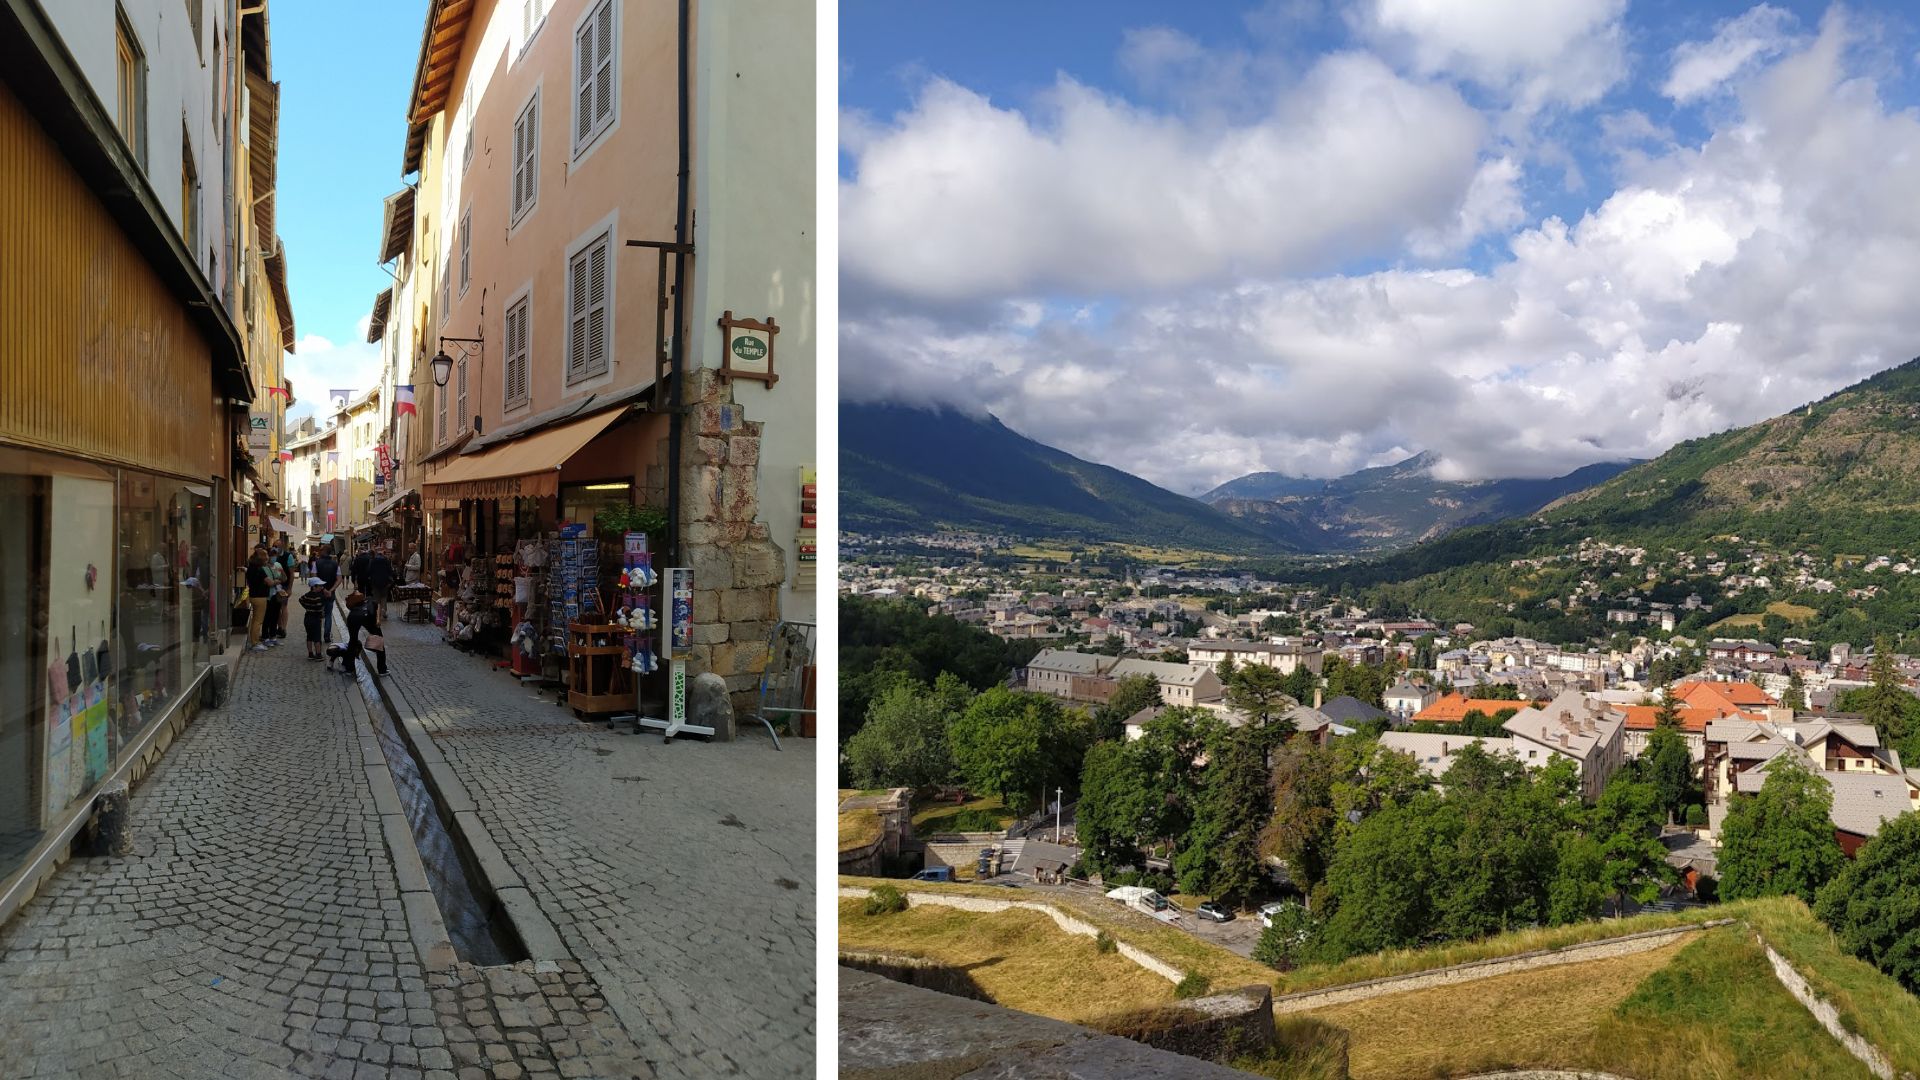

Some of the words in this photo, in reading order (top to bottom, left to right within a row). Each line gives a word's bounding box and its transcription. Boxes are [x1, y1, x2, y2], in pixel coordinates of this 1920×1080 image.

[744, 338, 754, 346] Rue
[743, 347, 764, 356] TEMPLE
[251, 417, 268, 428] CA
[380, 446, 392, 480] TABAC
[466, 480, 521, 496] SOUVENIRS
